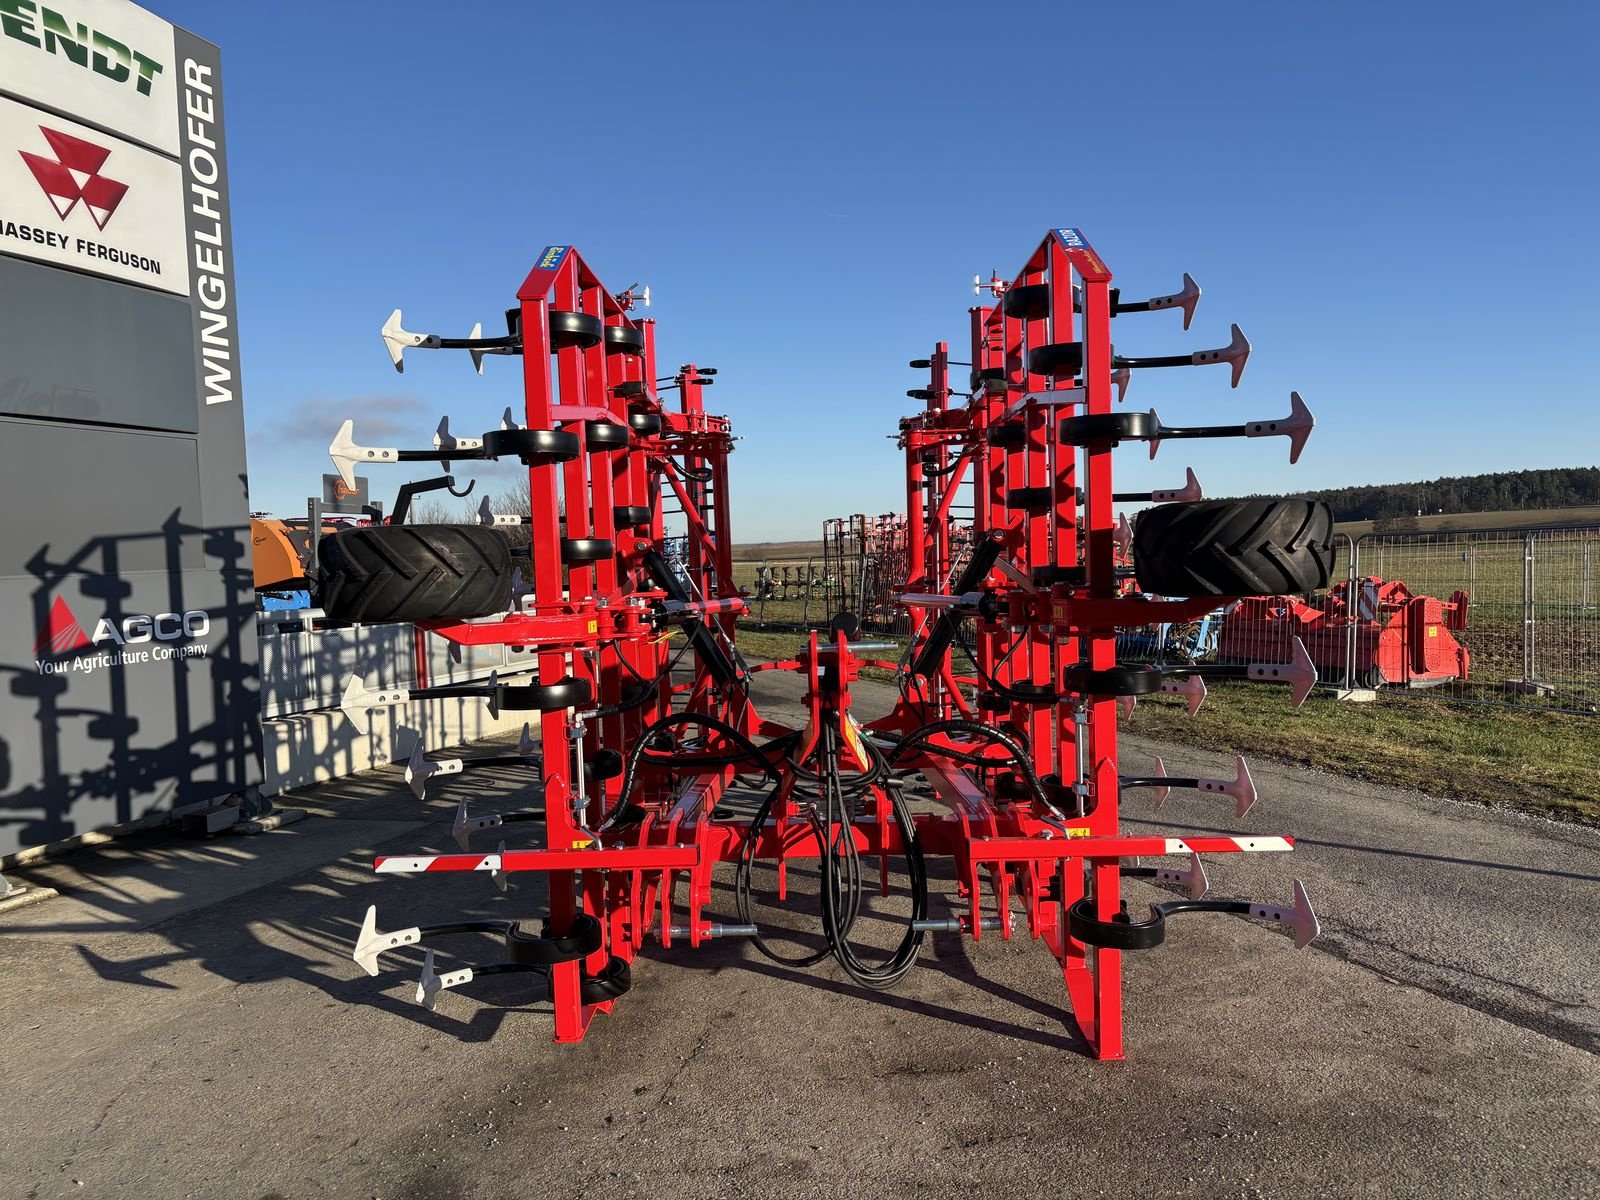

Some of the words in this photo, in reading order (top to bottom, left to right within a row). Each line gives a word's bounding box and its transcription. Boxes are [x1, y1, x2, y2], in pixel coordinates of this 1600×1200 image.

[0, 219, 69, 249] ASSEY
[77, 238, 161, 274] FERGUSON
[184, 58, 233, 405] WINGELHOFER
[91, 610, 210, 646] AGCO
[35, 659, 68, 675] Your
[73, 651, 149, 673] Agriculture
[152, 643, 208, 661] Company
